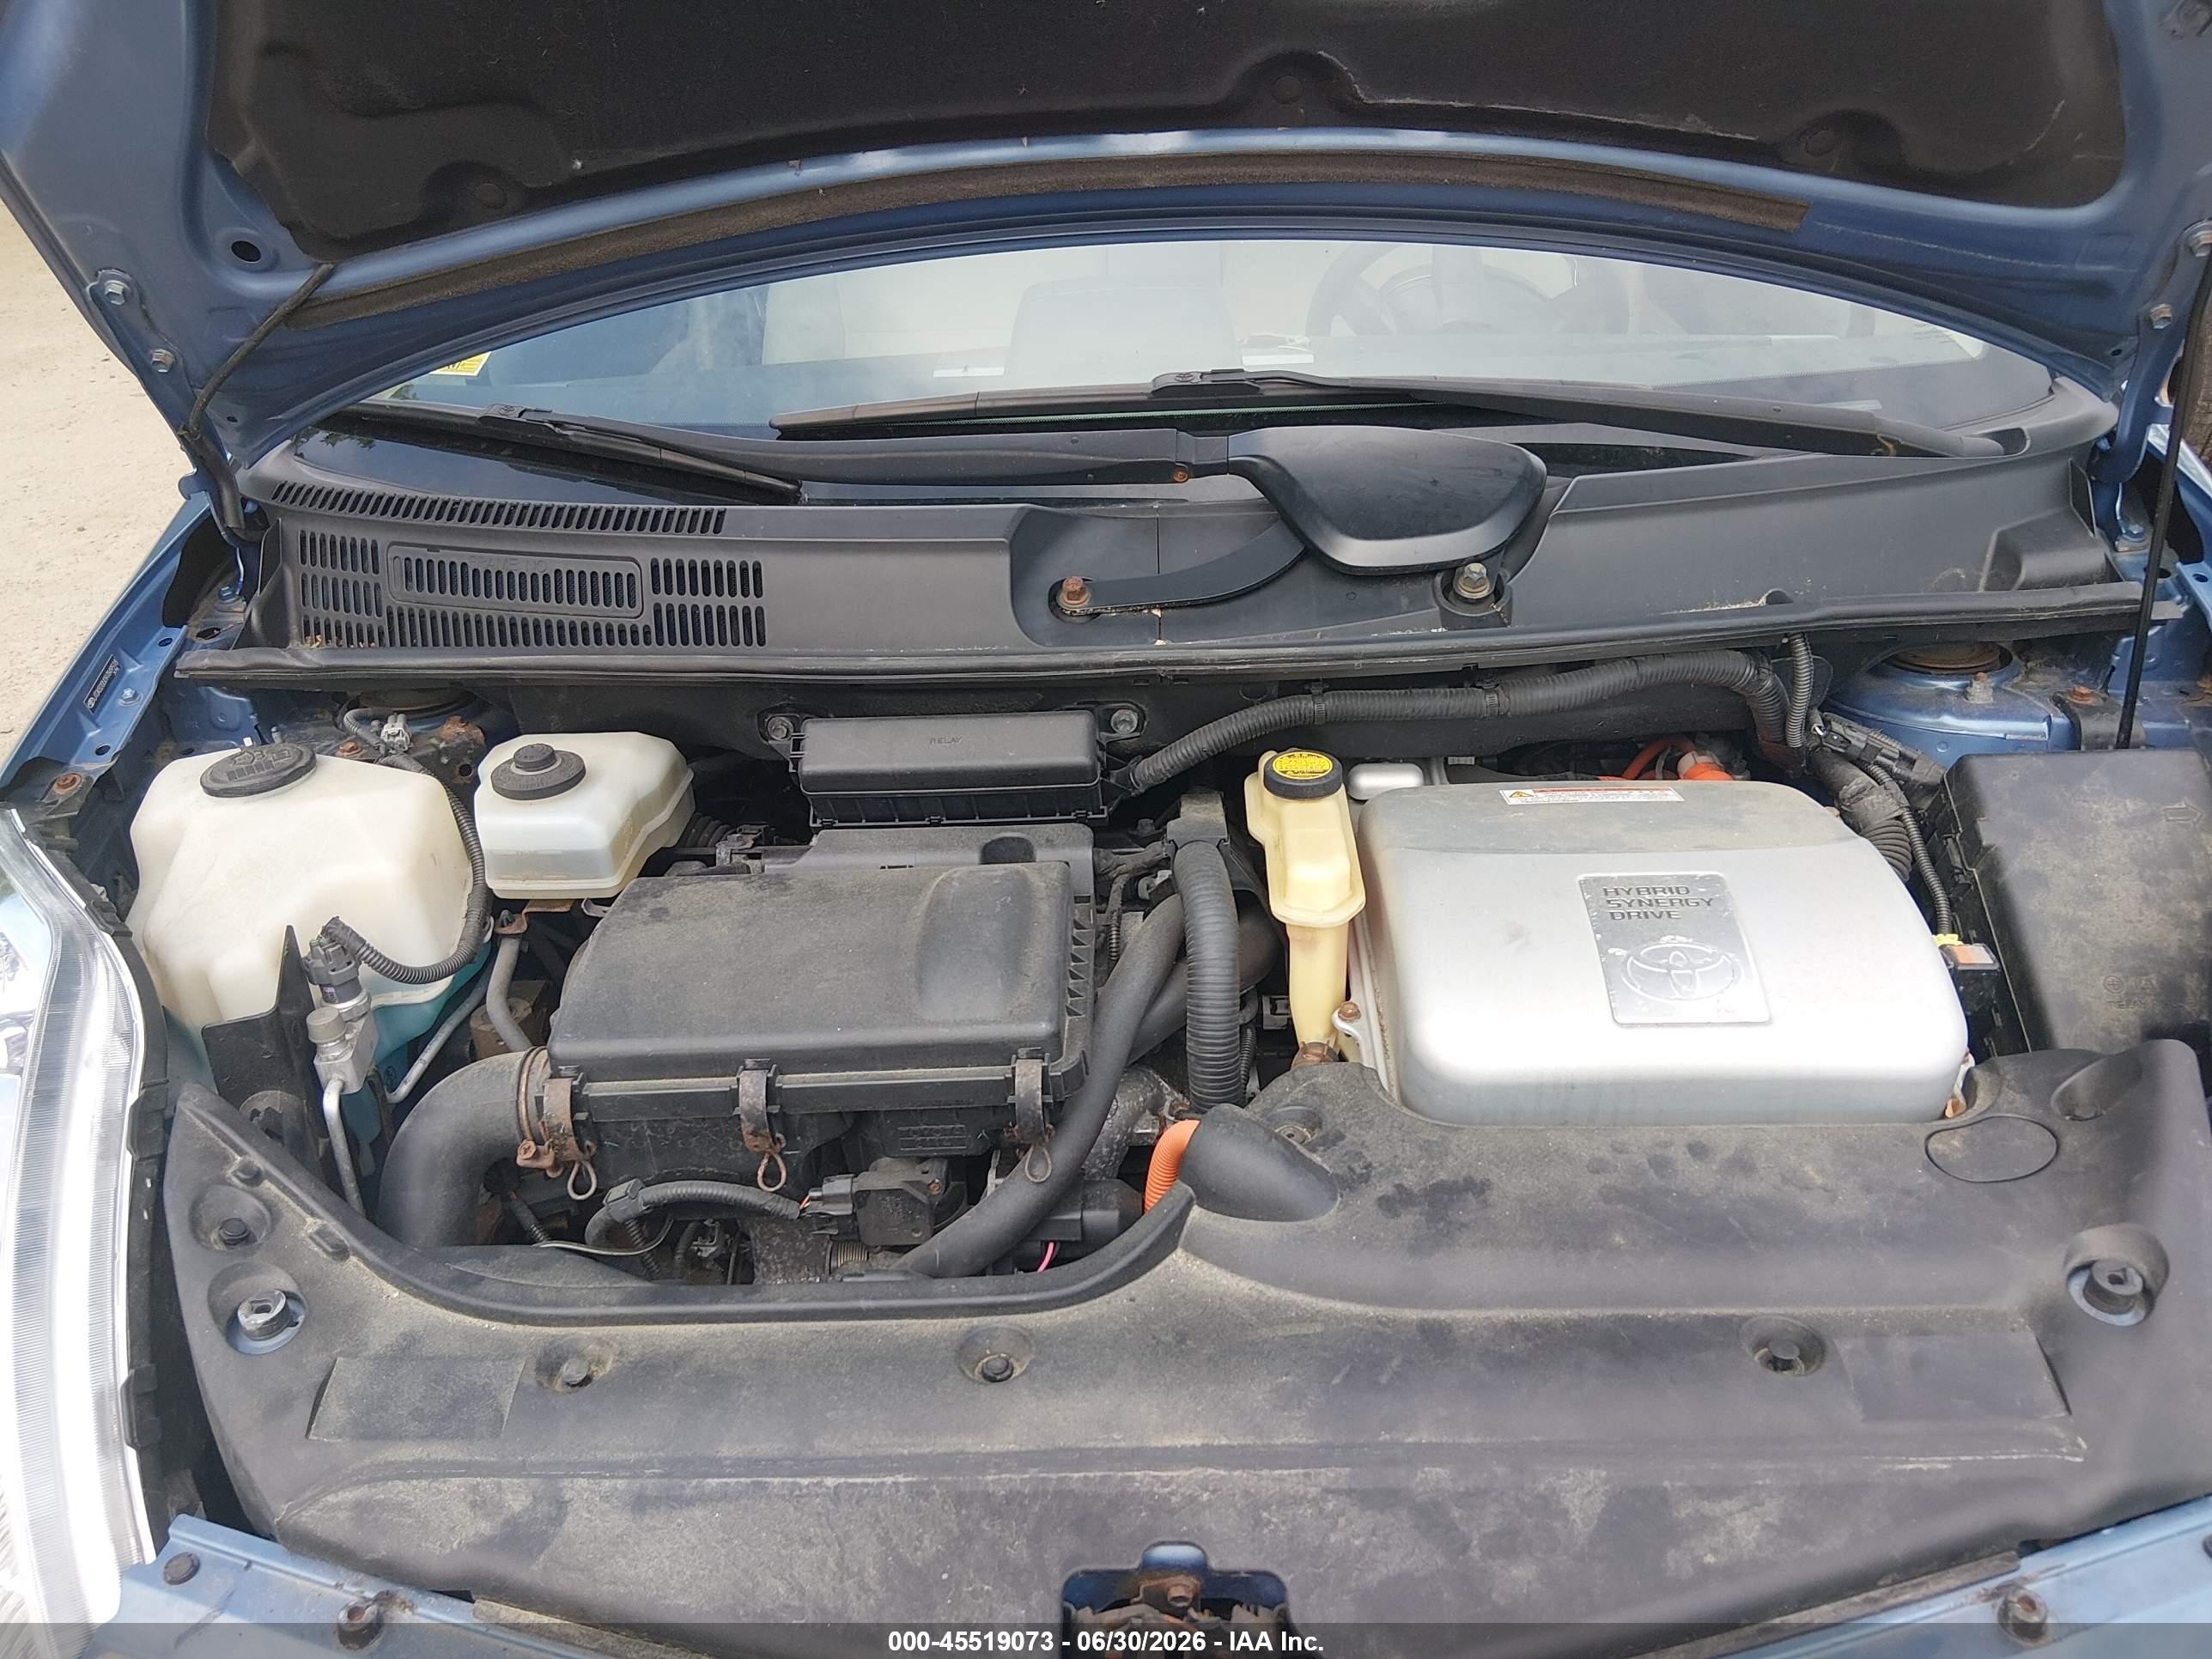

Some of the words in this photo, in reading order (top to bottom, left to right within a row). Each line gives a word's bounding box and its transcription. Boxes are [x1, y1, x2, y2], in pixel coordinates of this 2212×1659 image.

[929, 735, 963, 744] RELAY
[1602, 886, 1691, 896] HYBRID
[1606, 897, 1714, 908] SYNERGY
[1609, 909, 1683, 921] DRIVE
